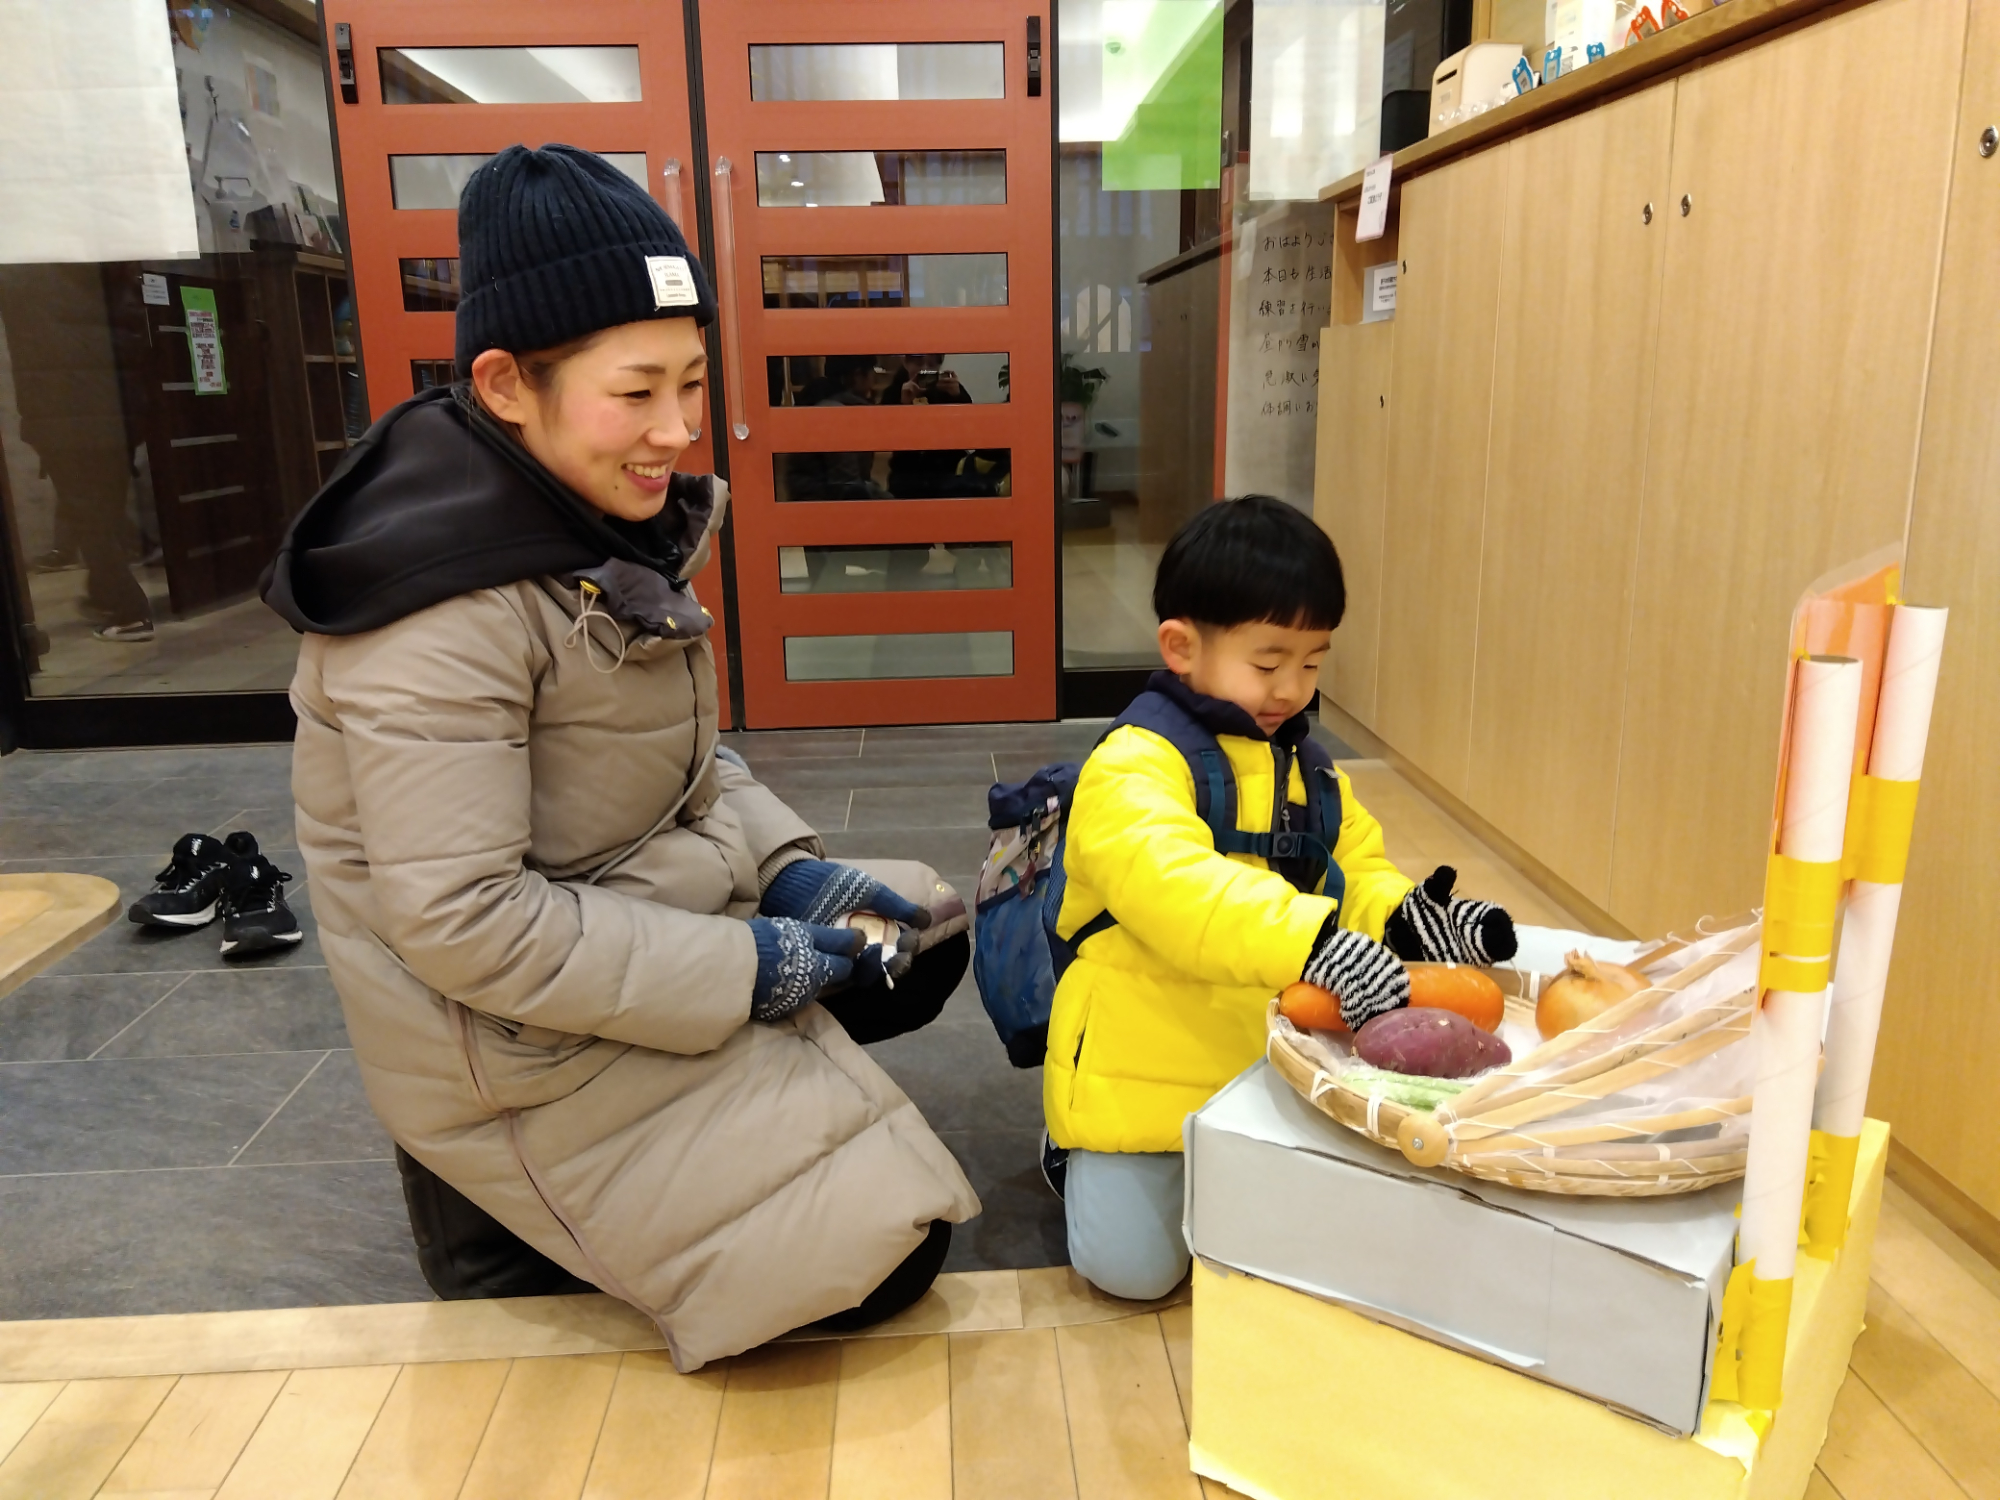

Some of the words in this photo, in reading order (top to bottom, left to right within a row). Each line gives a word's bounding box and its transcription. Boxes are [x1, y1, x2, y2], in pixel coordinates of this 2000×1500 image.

[1262, 265, 1332, 285] 本日も生活
[1260, 399, 1318, 418] 体調にお
